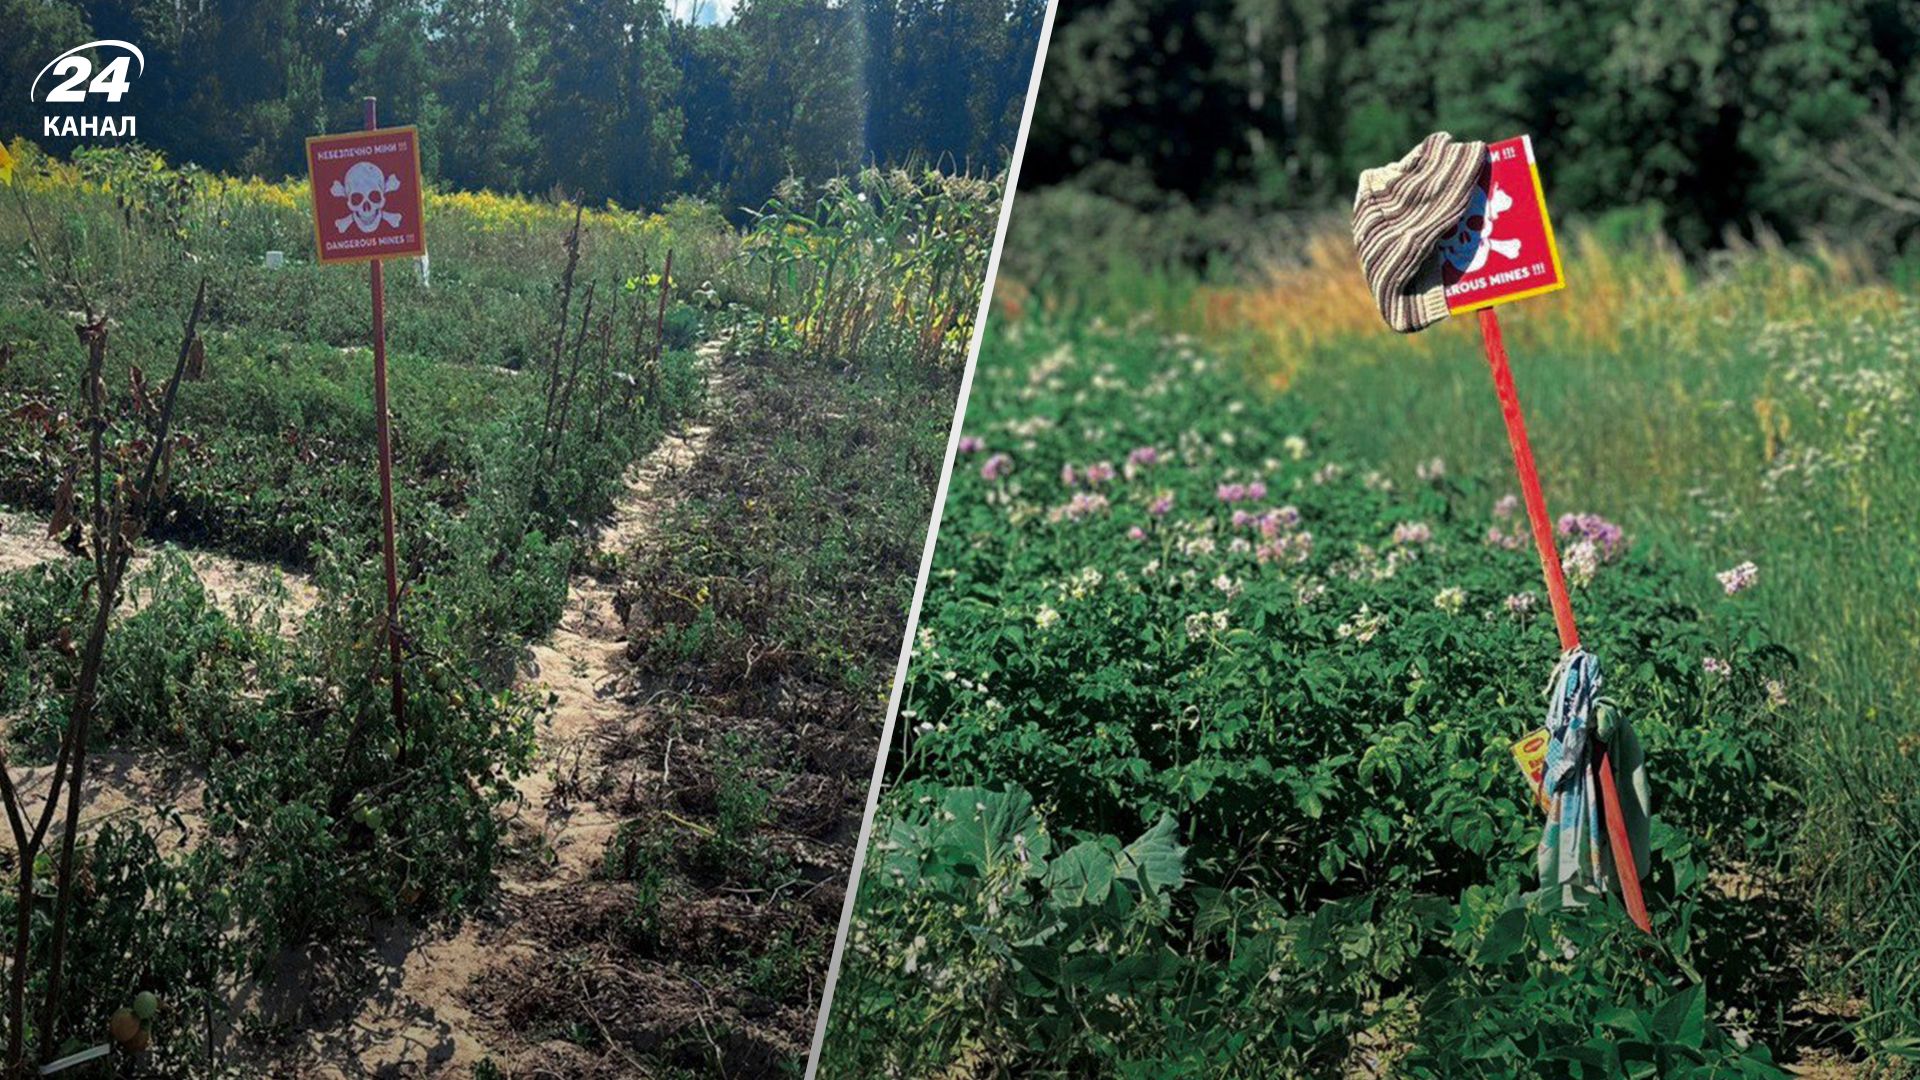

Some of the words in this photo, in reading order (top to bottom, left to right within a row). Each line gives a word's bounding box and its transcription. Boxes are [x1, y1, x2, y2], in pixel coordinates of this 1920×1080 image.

[1503, 147, 1515, 159] !!!
[326, 238, 377, 250] DANGEROUS
[379, 235, 404, 245] MINES
[1489, 267, 1530, 285] MINES
[1532, 263, 1545, 275] !!!
